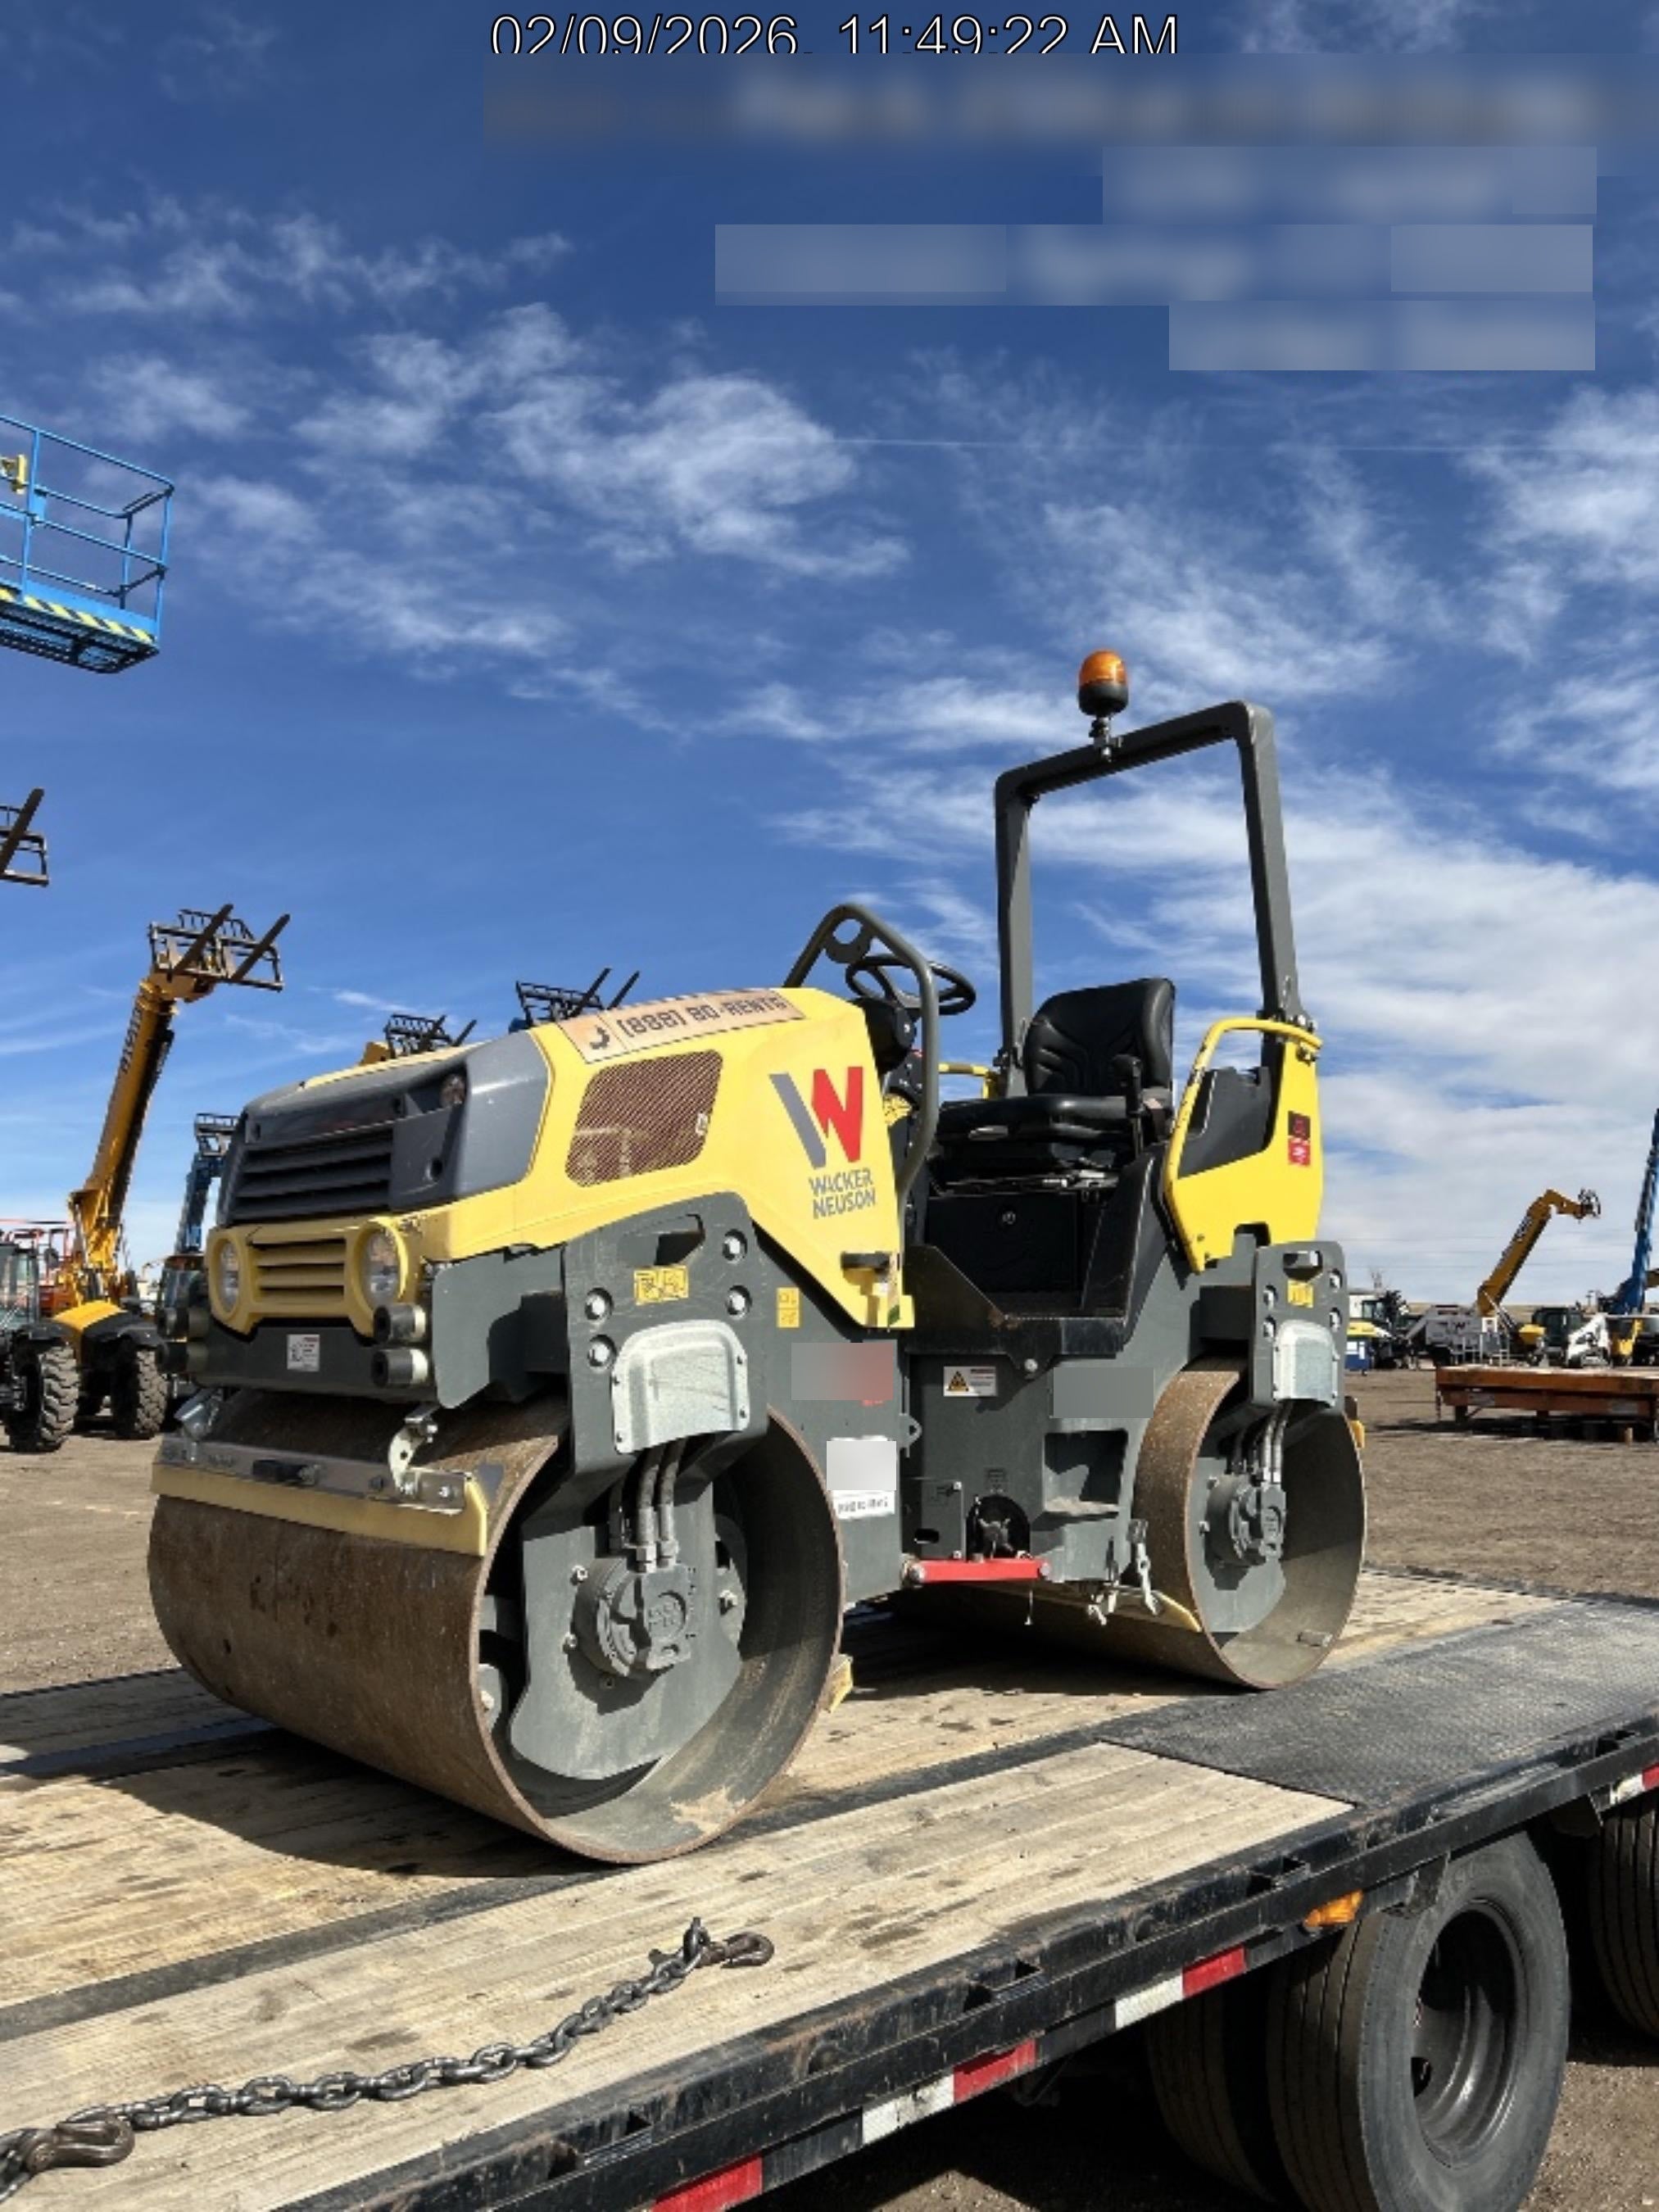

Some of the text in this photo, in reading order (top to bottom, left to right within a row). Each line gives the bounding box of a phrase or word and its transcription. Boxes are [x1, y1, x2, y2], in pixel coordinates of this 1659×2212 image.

[617, 1009, 688, 1038] (888)
[809, 1167, 873, 1197] WACKER
[813, 1188, 876, 1219] NEUSON
